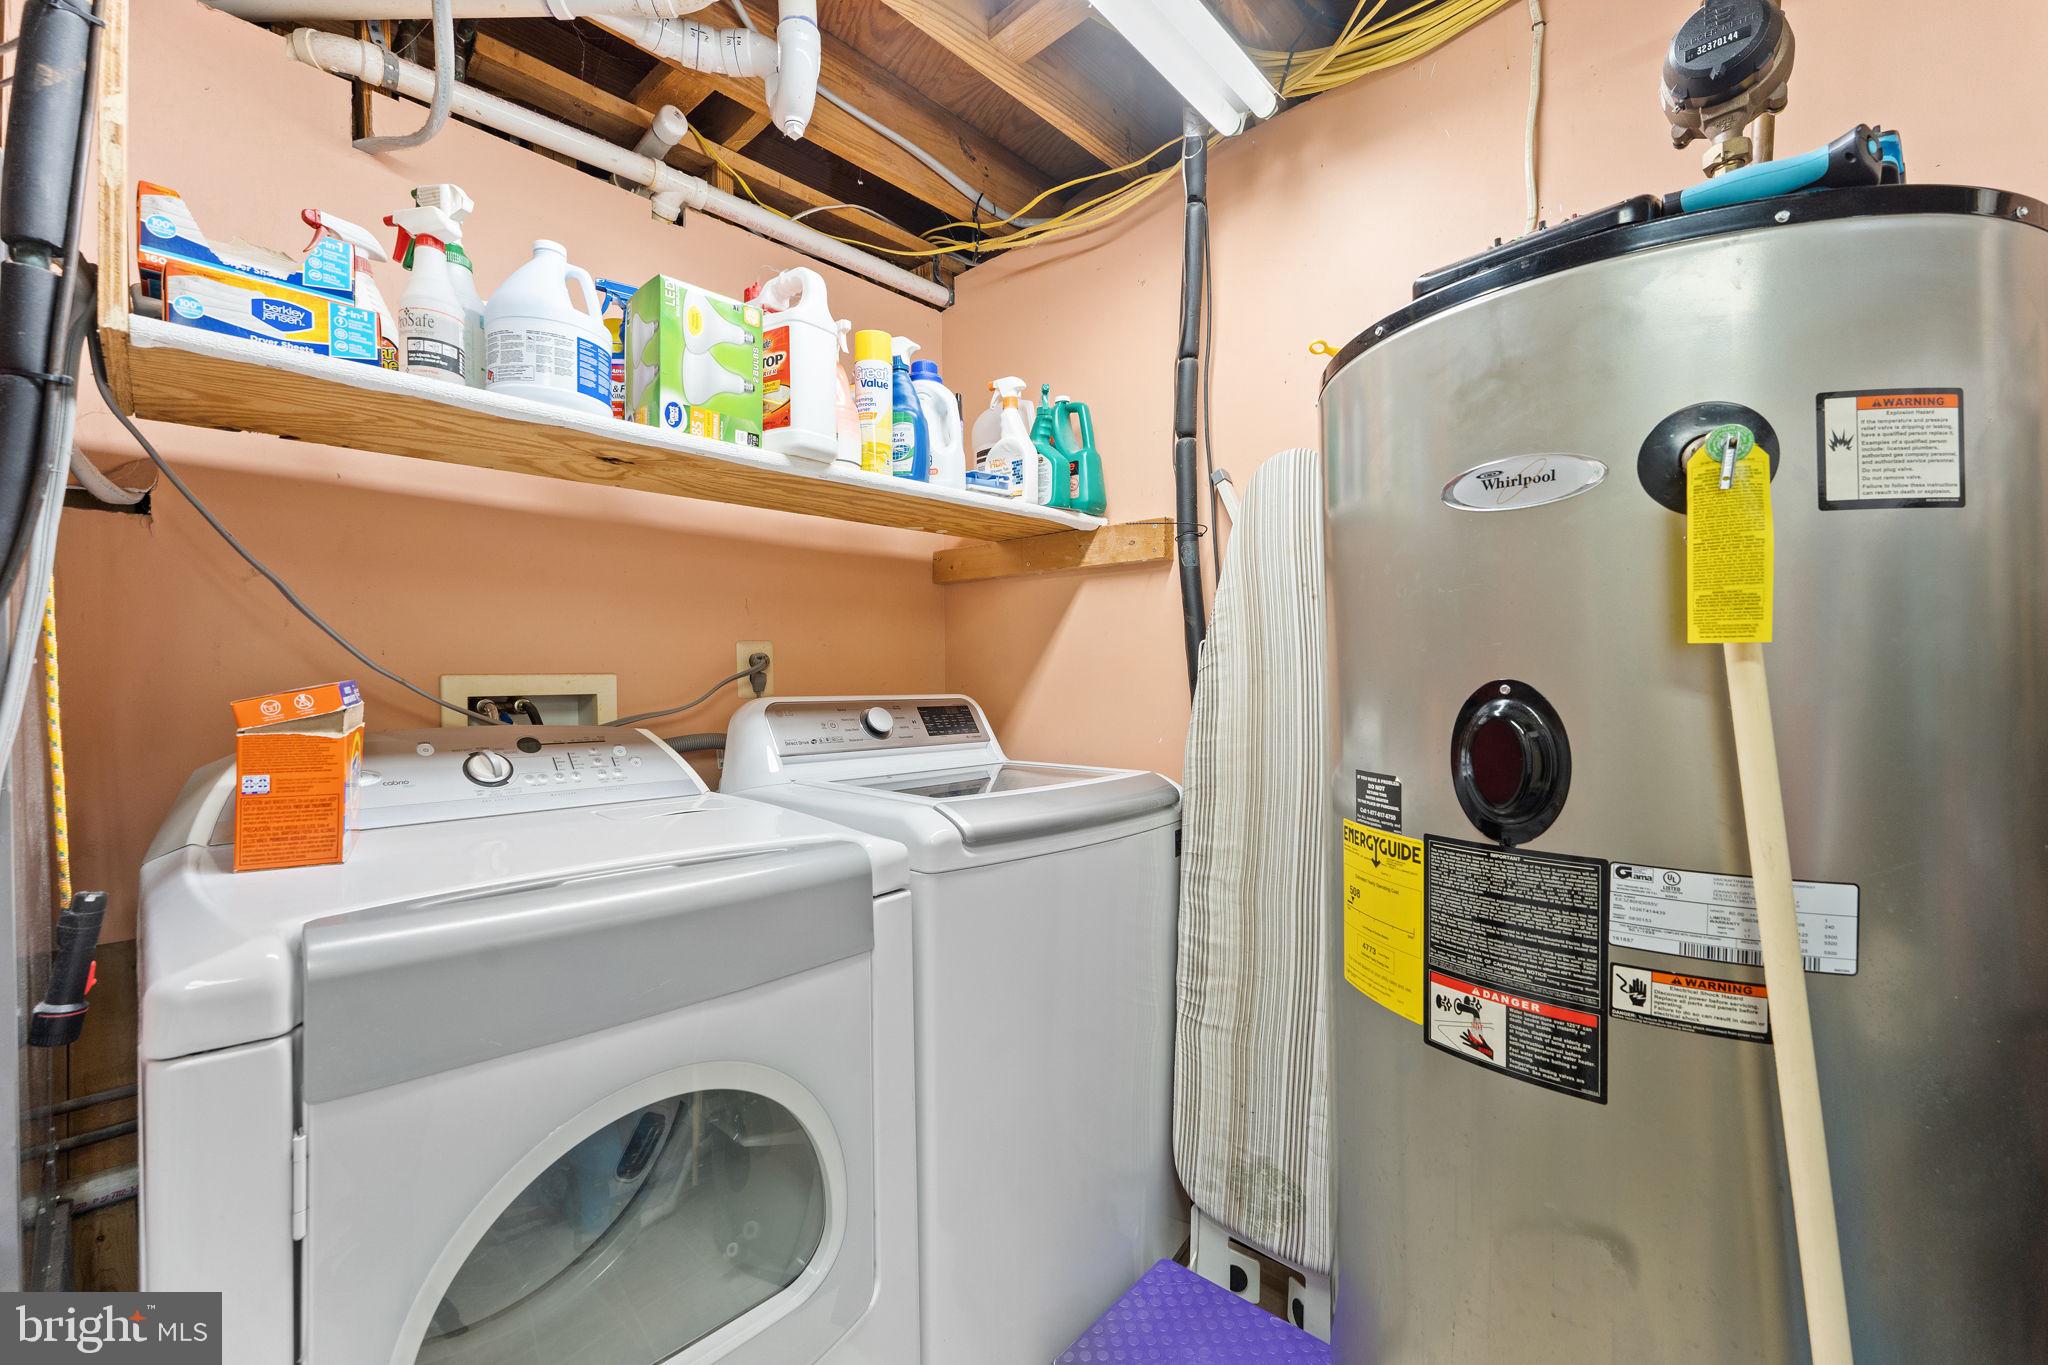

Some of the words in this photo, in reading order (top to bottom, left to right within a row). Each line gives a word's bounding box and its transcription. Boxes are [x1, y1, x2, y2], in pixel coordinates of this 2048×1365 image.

[1697, 31, 1738, 55] 32370144
[319, 240, 344, 253] -in-1
[664, 281, 676, 307] LED
[262, 301, 305, 319] berkley
[337, 305, 369, 321] 3-in-1
[763, 353, 785, 369] TOP
[856, 366, 889, 381] Great
[860, 378, 889, 389] Value
[1883, 398, 1944, 406] WARNING
[1482, 469, 1556, 491] Whirlpool
[1344, 825, 1421, 865] ENERGYGUIDE
[1490, 853, 1521, 862] IMPORTANT
[1349, 885, 1361, 899] 508
[1467, 954, 1484, 963] STATE
[1493, 961, 1525, 974] CALIFORNIA
[1526, 969, 1548, 978] NOTICE
[1670, 986, 1698, 994] Electrical
[1685, 978, 1753, 994] WARNING
[1482, 988, 1541, 1013] DANGER
[1654, 989, 1687, 999] Disconnect
[1654, 995, 1677, 1003] Replace
[1612, 1009, 1636, 1018] DANGER:
[1653, 1011, 1681, 1019] electrical
[1654, 1005, 1674, 1013] Failure
[1524, 1012, 1552, 1022] temperature
[1557, 1025, 1578, 1035] instantly
